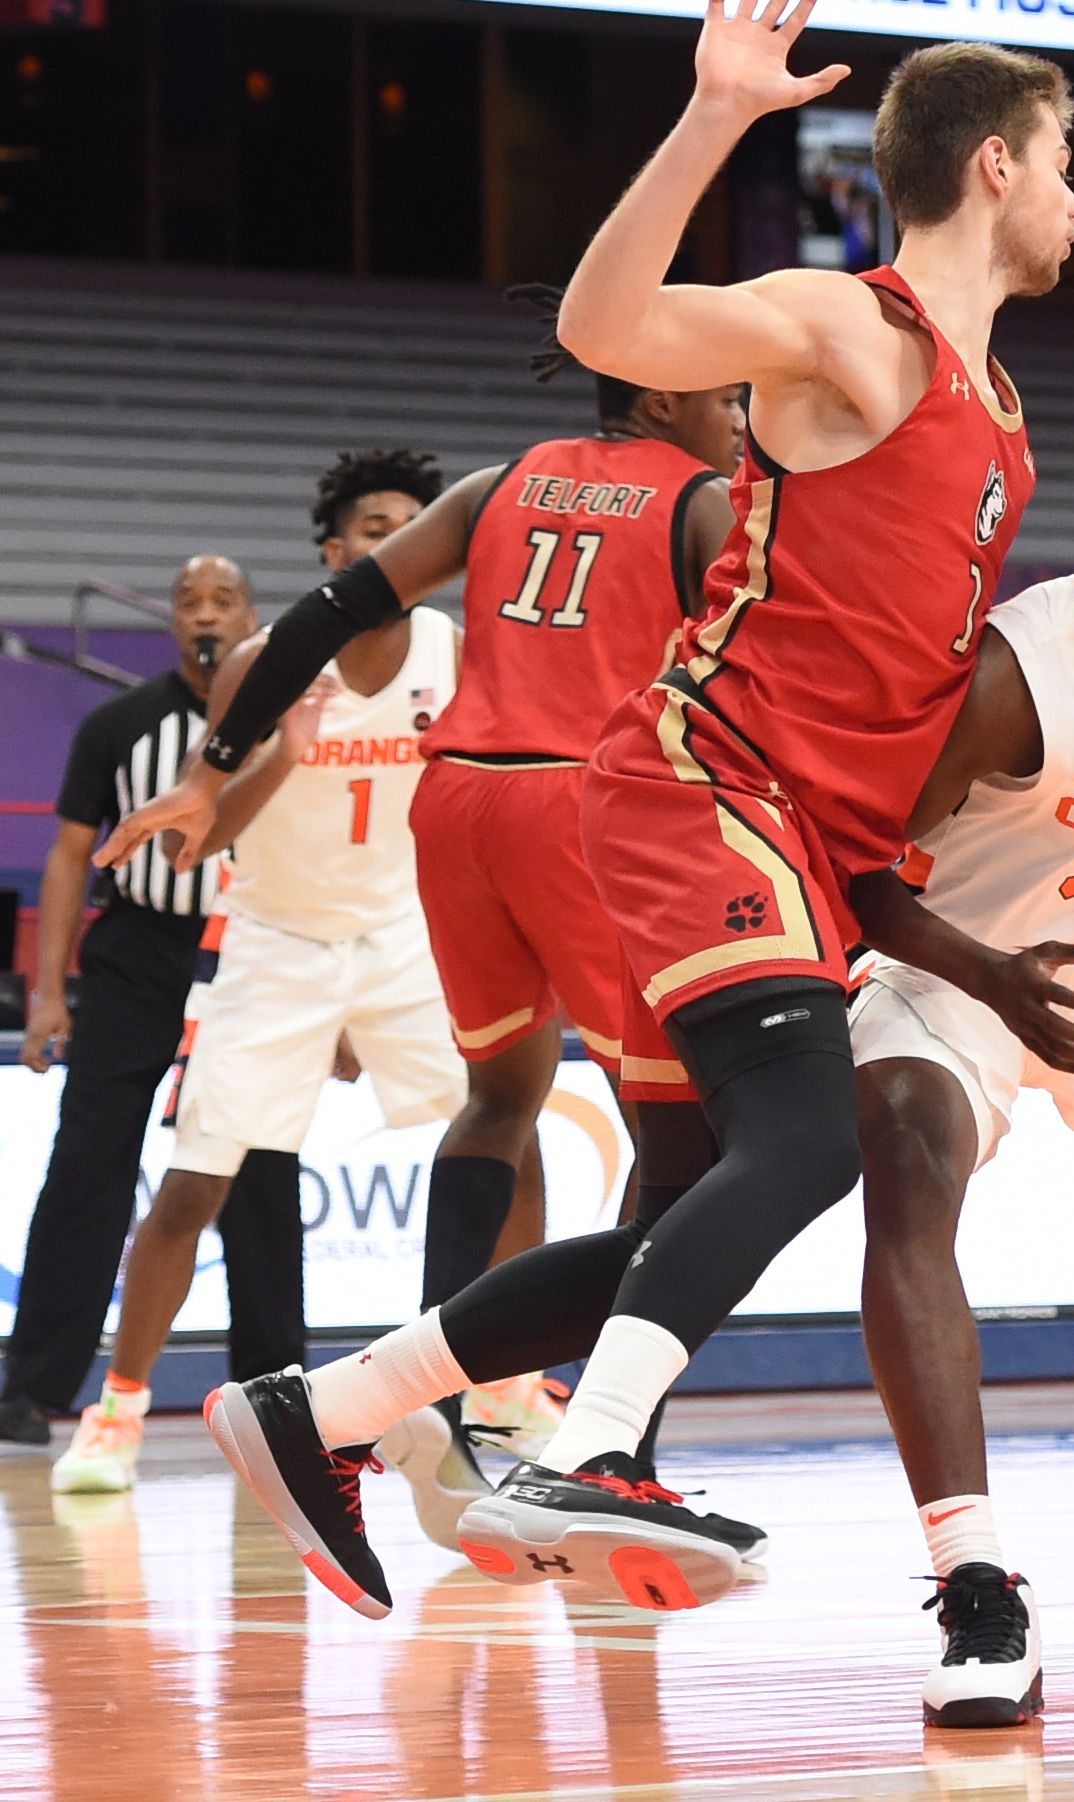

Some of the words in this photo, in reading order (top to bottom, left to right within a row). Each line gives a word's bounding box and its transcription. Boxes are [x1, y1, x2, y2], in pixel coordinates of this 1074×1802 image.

[517, 474, 658, 519] TELFORT
[498, 527, 605, 628] 11
[348, 777, 372, 845] 1
